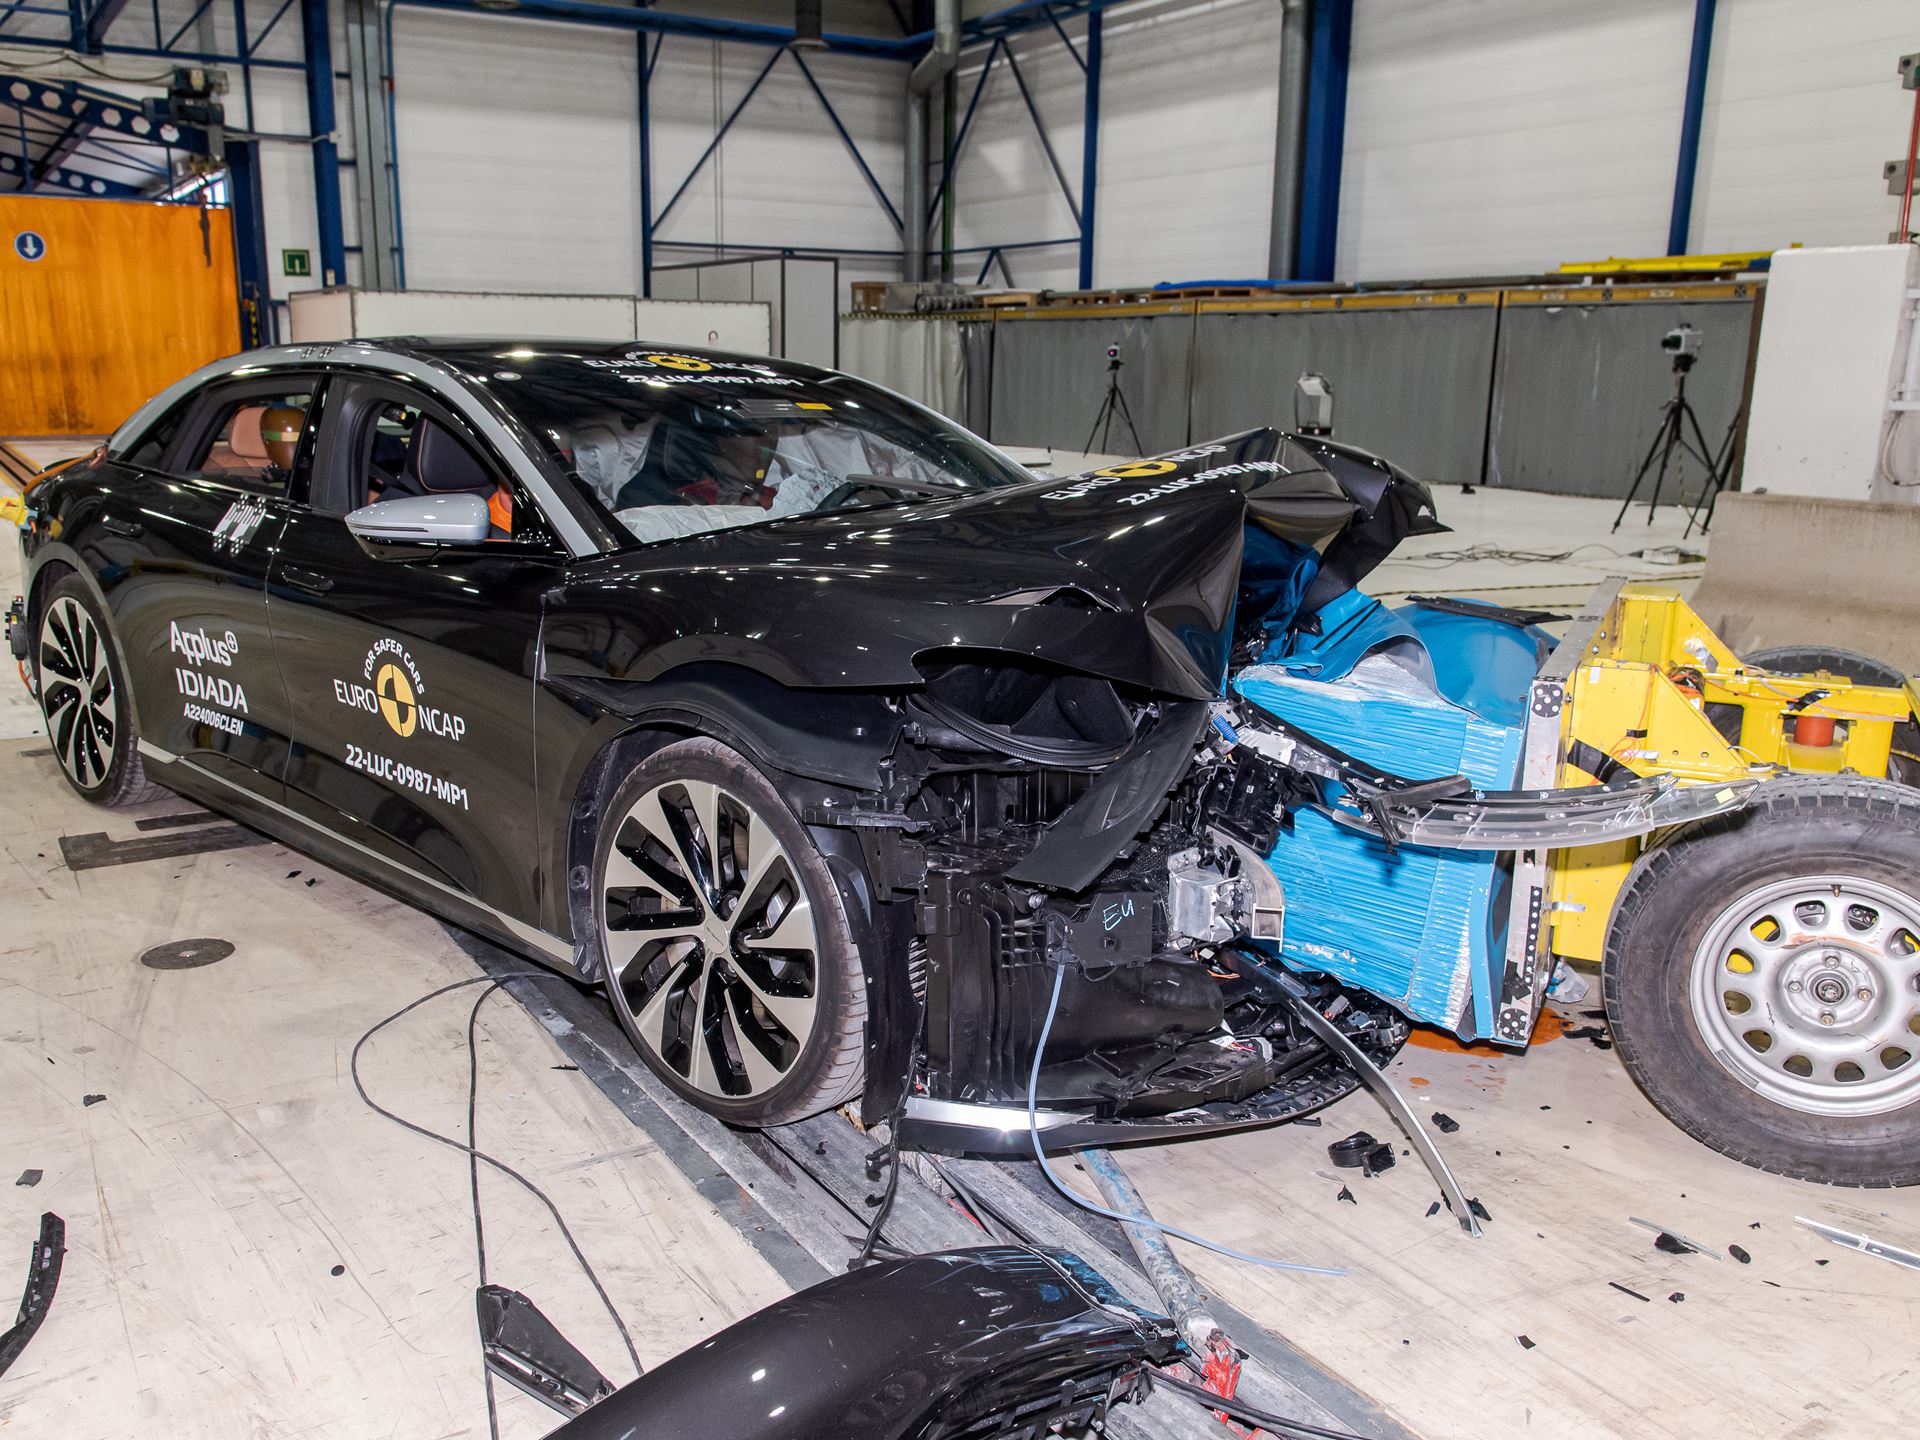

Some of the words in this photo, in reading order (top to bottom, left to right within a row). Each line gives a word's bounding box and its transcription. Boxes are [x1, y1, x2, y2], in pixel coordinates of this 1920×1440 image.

[583, 360, 657, 369] EURO
[1040, 476, 1122, 500] EURO
[364, 650, 376, 680] FOR
[374, 638, 402, 657] SAFER
[403, 652, 425, 694] CARS
[175, 668, 248, 713] IDIADA
[333, 678, 378, 714] EURO
[417, 704, 465, 741] NCAP
[184, 703, 243, 736] A224006CLEN
[345, 743, 469, 810] 22-LUC-0987-MP1
